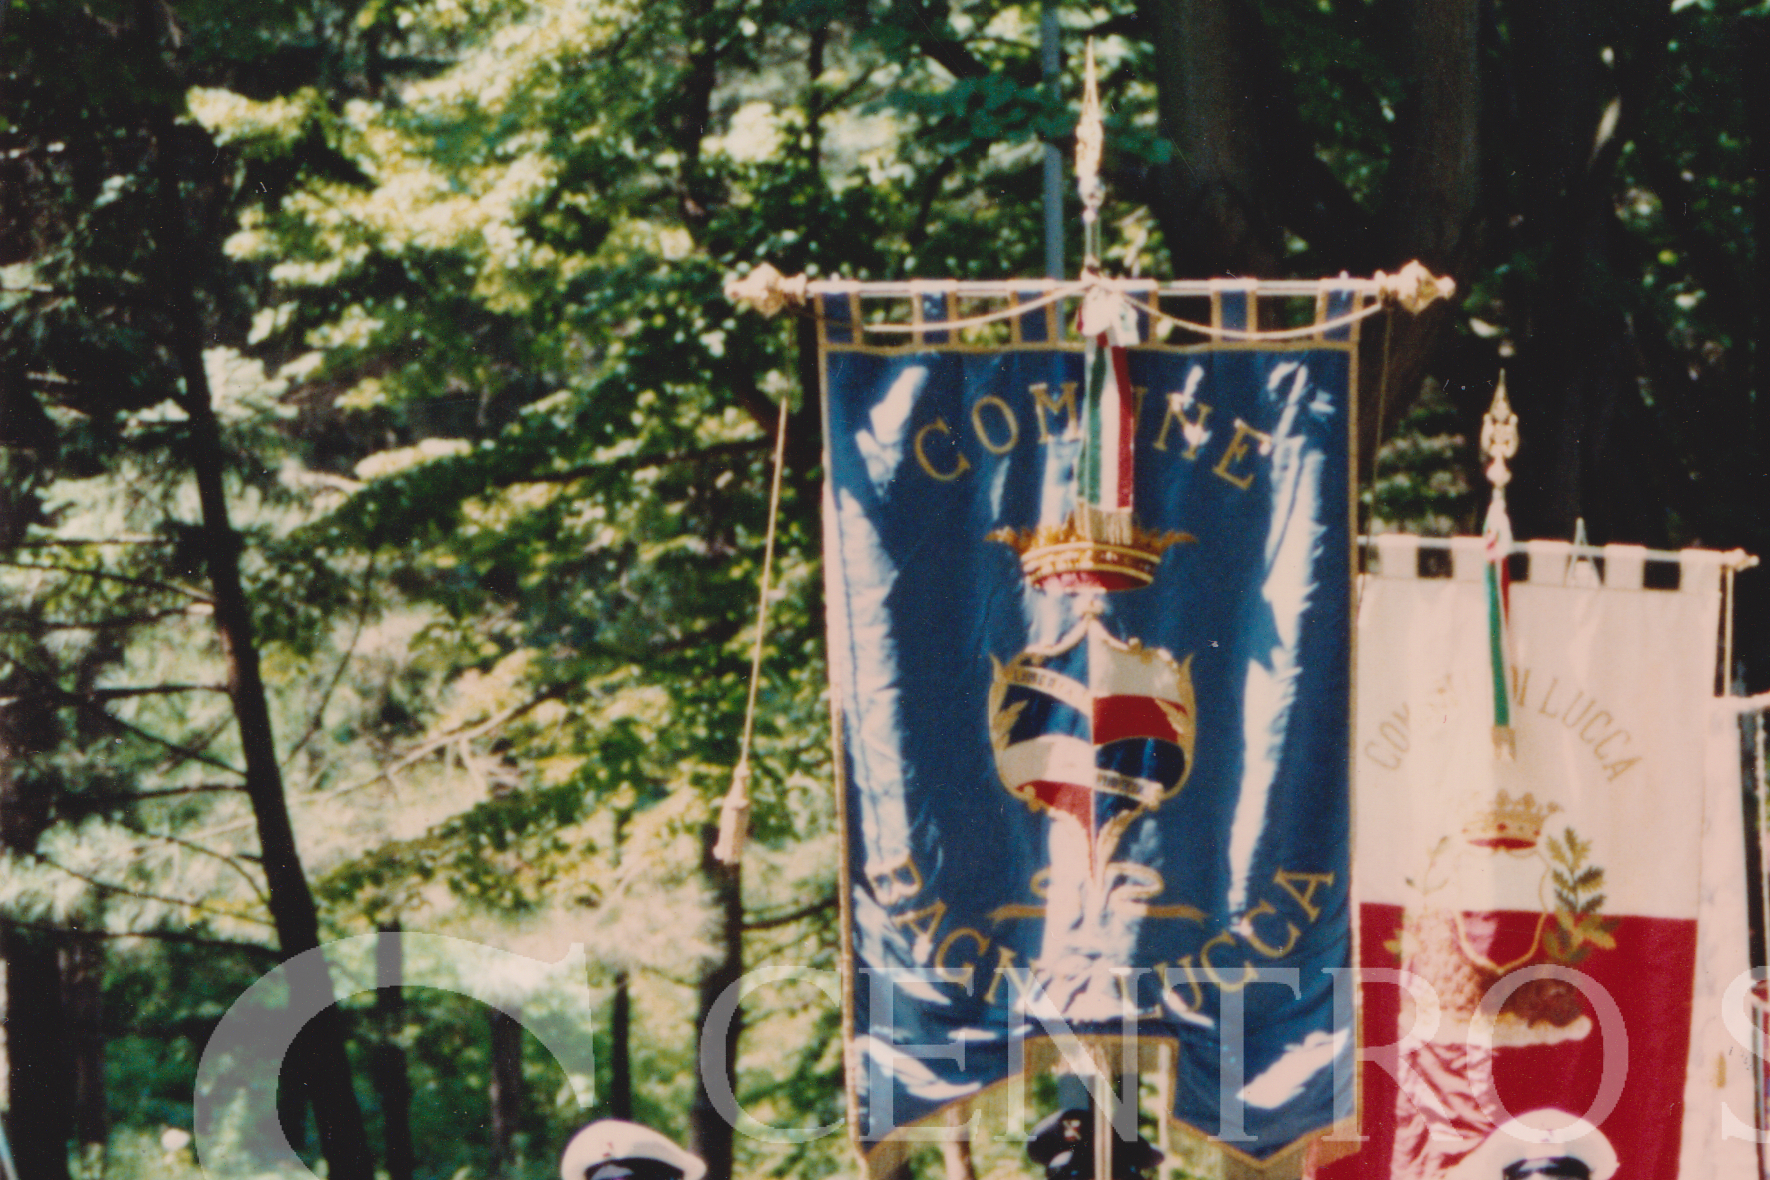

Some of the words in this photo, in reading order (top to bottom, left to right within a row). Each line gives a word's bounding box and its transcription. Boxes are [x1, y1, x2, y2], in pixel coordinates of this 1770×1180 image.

[1538, 676, 1643, 783] LUCCA
[865, 855, 1045, 1008] BAGN
[1117, 867, 1335, 1021] LUCCA
